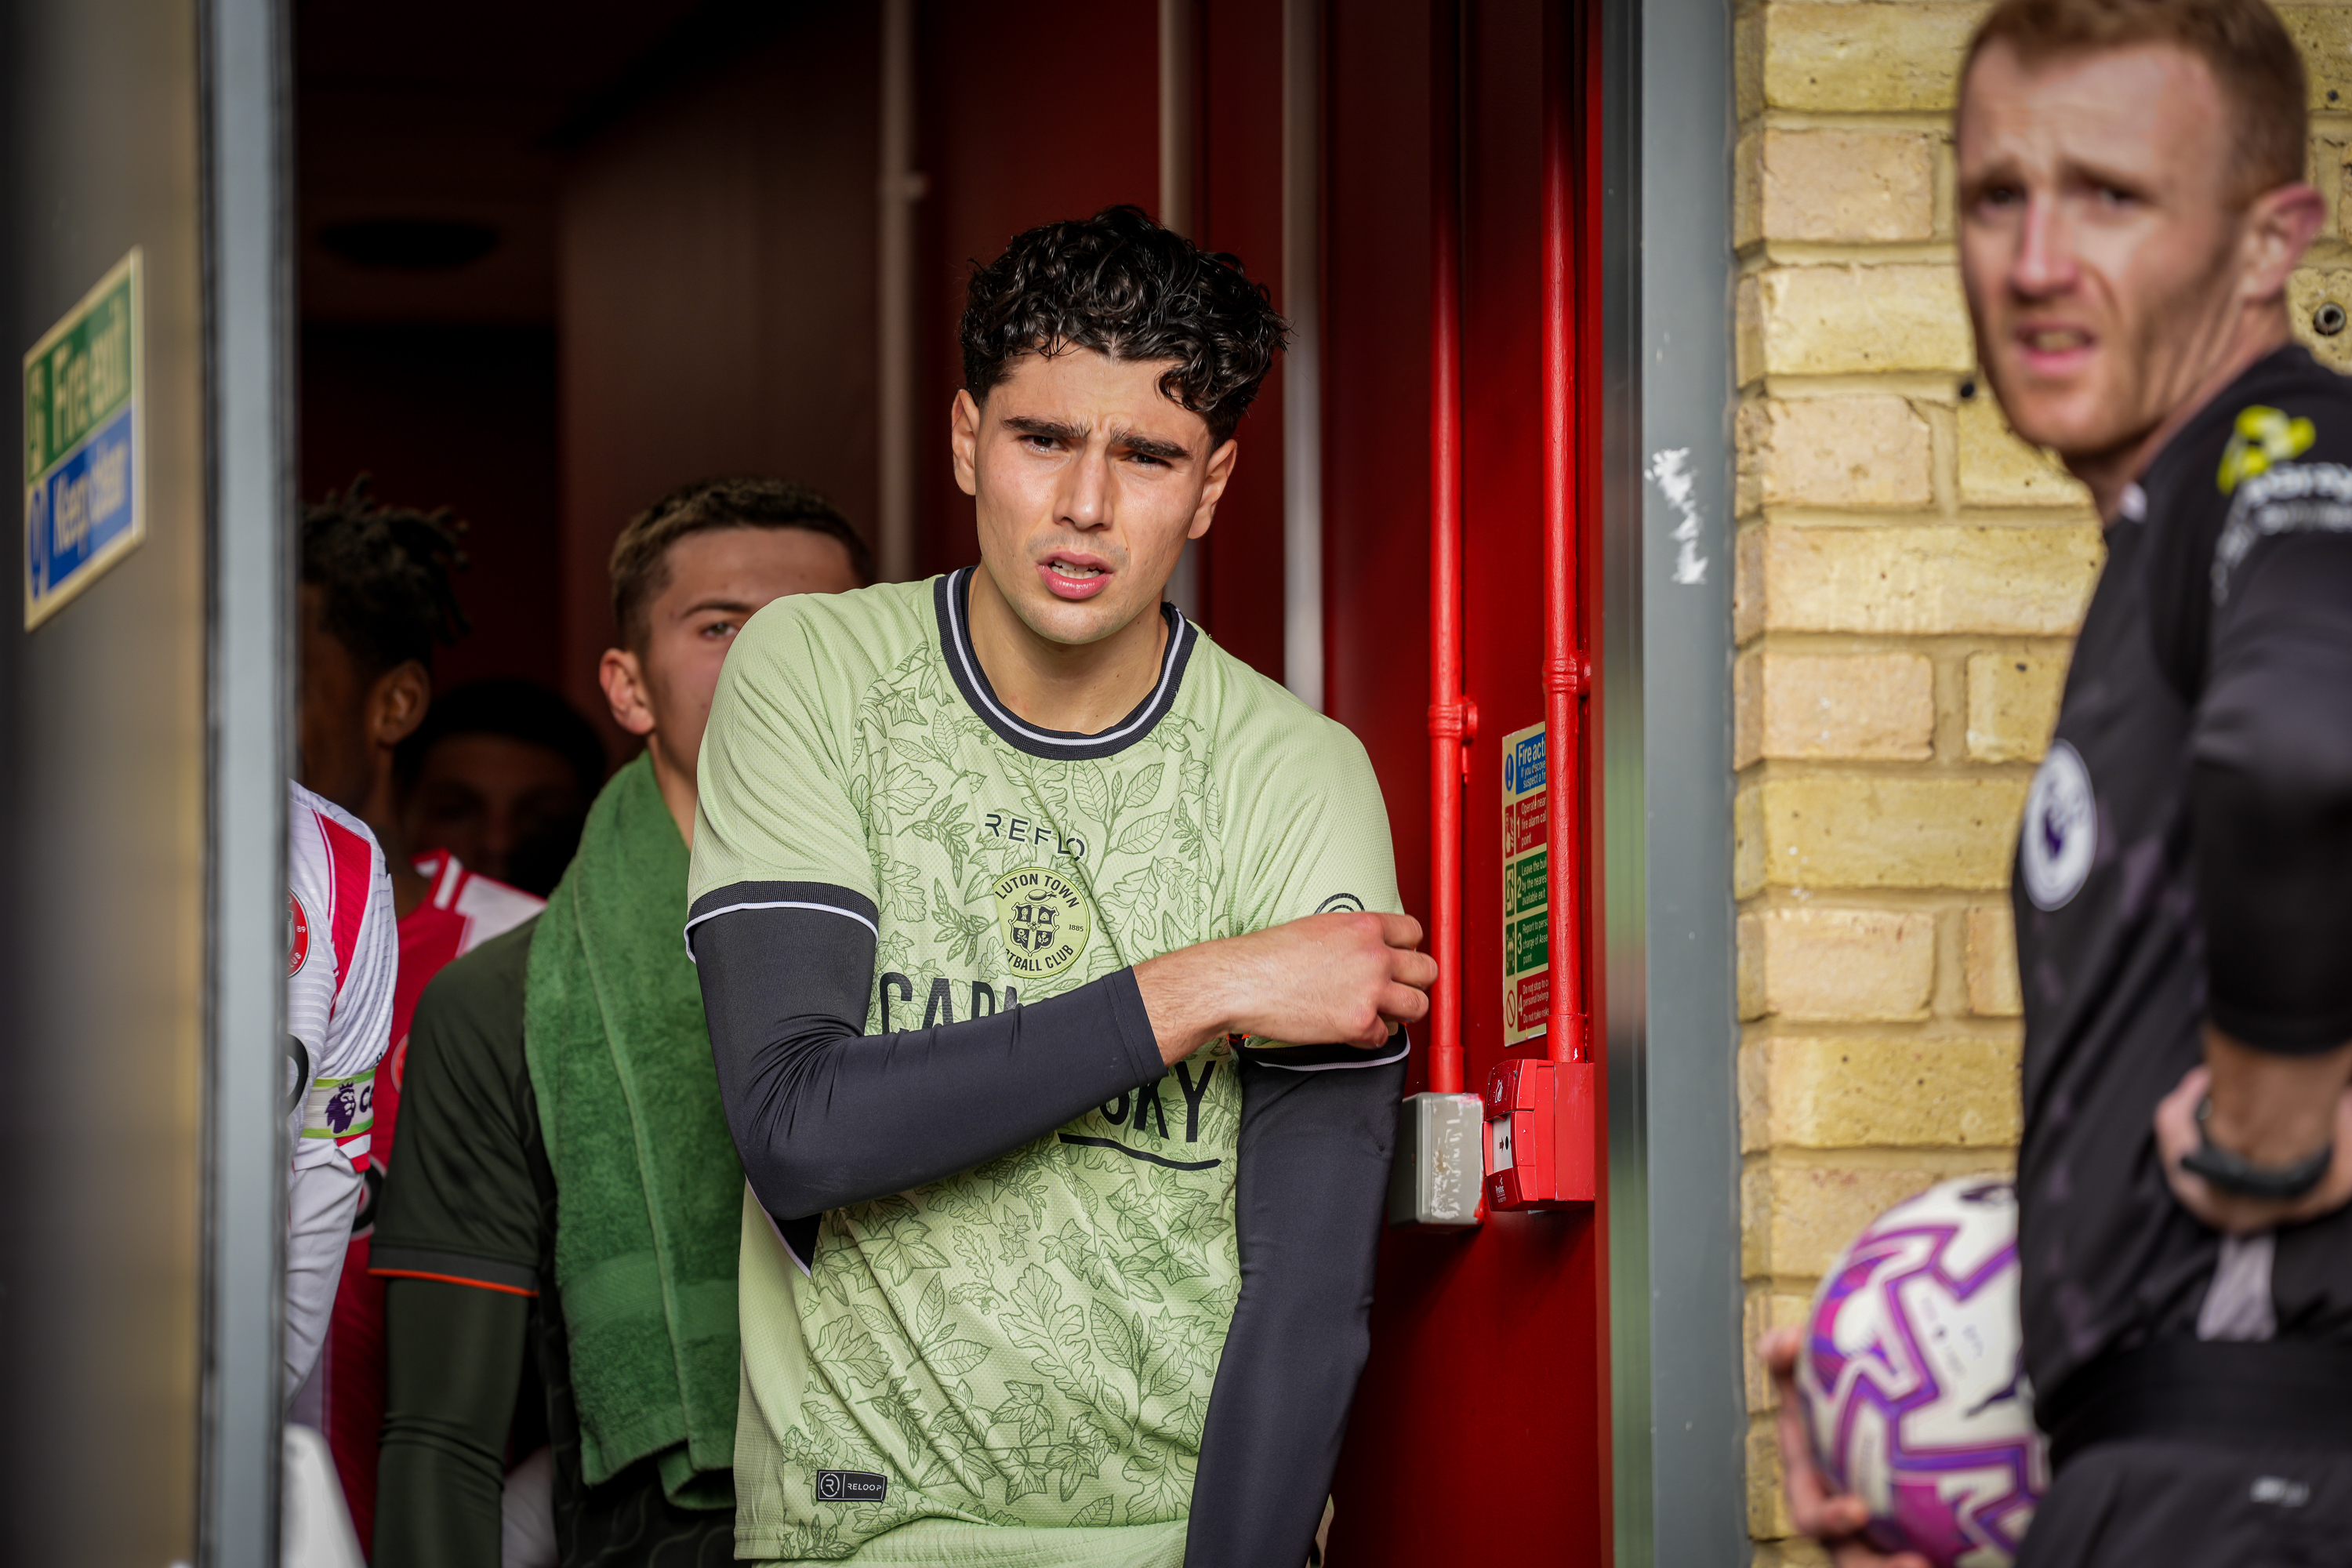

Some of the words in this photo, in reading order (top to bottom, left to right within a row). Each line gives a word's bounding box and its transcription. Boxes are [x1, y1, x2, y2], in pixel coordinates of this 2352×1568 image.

[53, 343, 89, 454] Fire
[1519, 743, 1532, 767] Fire
[1523, 773, 1538, 789] suspect
[1538, 774, 1541, 782] a
[1522, 799, 1537, 816] Operate
[1517, 816, 1520, 839] 1
[1529, 815, 1540, 828] alarm
[985, 814, 1085, 861] REFLO
[1522, 833, 1531, 849] point
[1522, 865, 1533, 877] Leave
[995, 873, 1038, 900] LUTON
[1044, 875, 1080, 908] TOWN
[1517, 876, 1522, 898] 2
[1522, 880, 1526, 893] by
[1522, 891, 1537, 906] available
[1523, 920, 1534, 935] Report
[1535, 920, 1538, 930] to
[1518, 932, 1522, 955] 3
[1523, 938, 1534, 950] charge
[1535, 935, 1539, 946] of
[1045, 945, 1074, 969] CLUB
[1523, 953, 1532, 967] point
[1523, 985, 1527, 995] Do
[1541, 979, 1545, 988] to
[1519, 994, 1523, 1016] 4
[1523, 993, 1537, 1009] personal
[1523, 1014, 1528, 1024] Do
